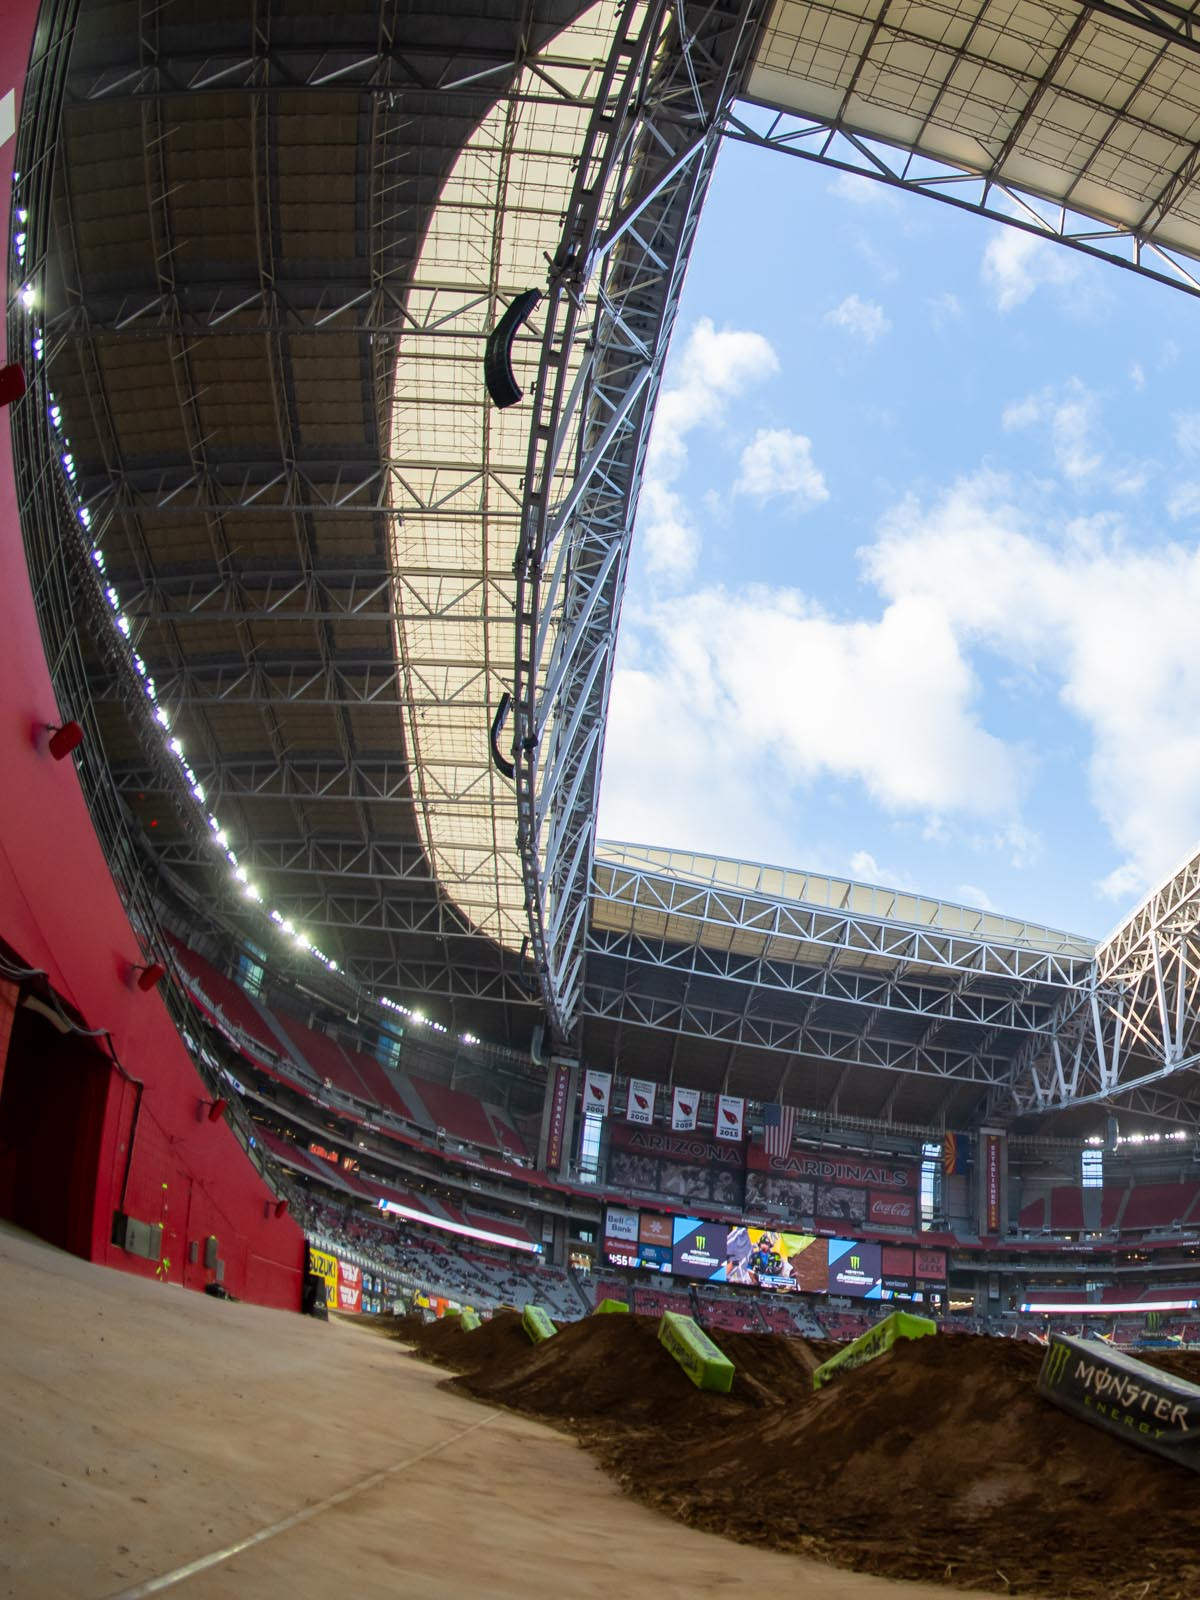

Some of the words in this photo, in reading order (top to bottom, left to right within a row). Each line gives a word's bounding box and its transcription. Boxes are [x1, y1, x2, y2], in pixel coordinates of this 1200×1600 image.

[629, 1131, 743, 1164] ARIZONA
[769, 1155, 909, 1187] CARDINALS
[871, 1200, 912, 1217] Coca-Cola
[607, 1215, 624, 1224] Bell
[611, 1225, 632, 1233] Bank
[310, 1254, 336, 1279] SUZUKI
[608, 1252, 628, 1266] 4:56
[885, 1280, 909, 1289] verizon
[1074, 1360, 1190, 1432] MONSTER
[1084, 1395, 1166, 1440] ENERGY
